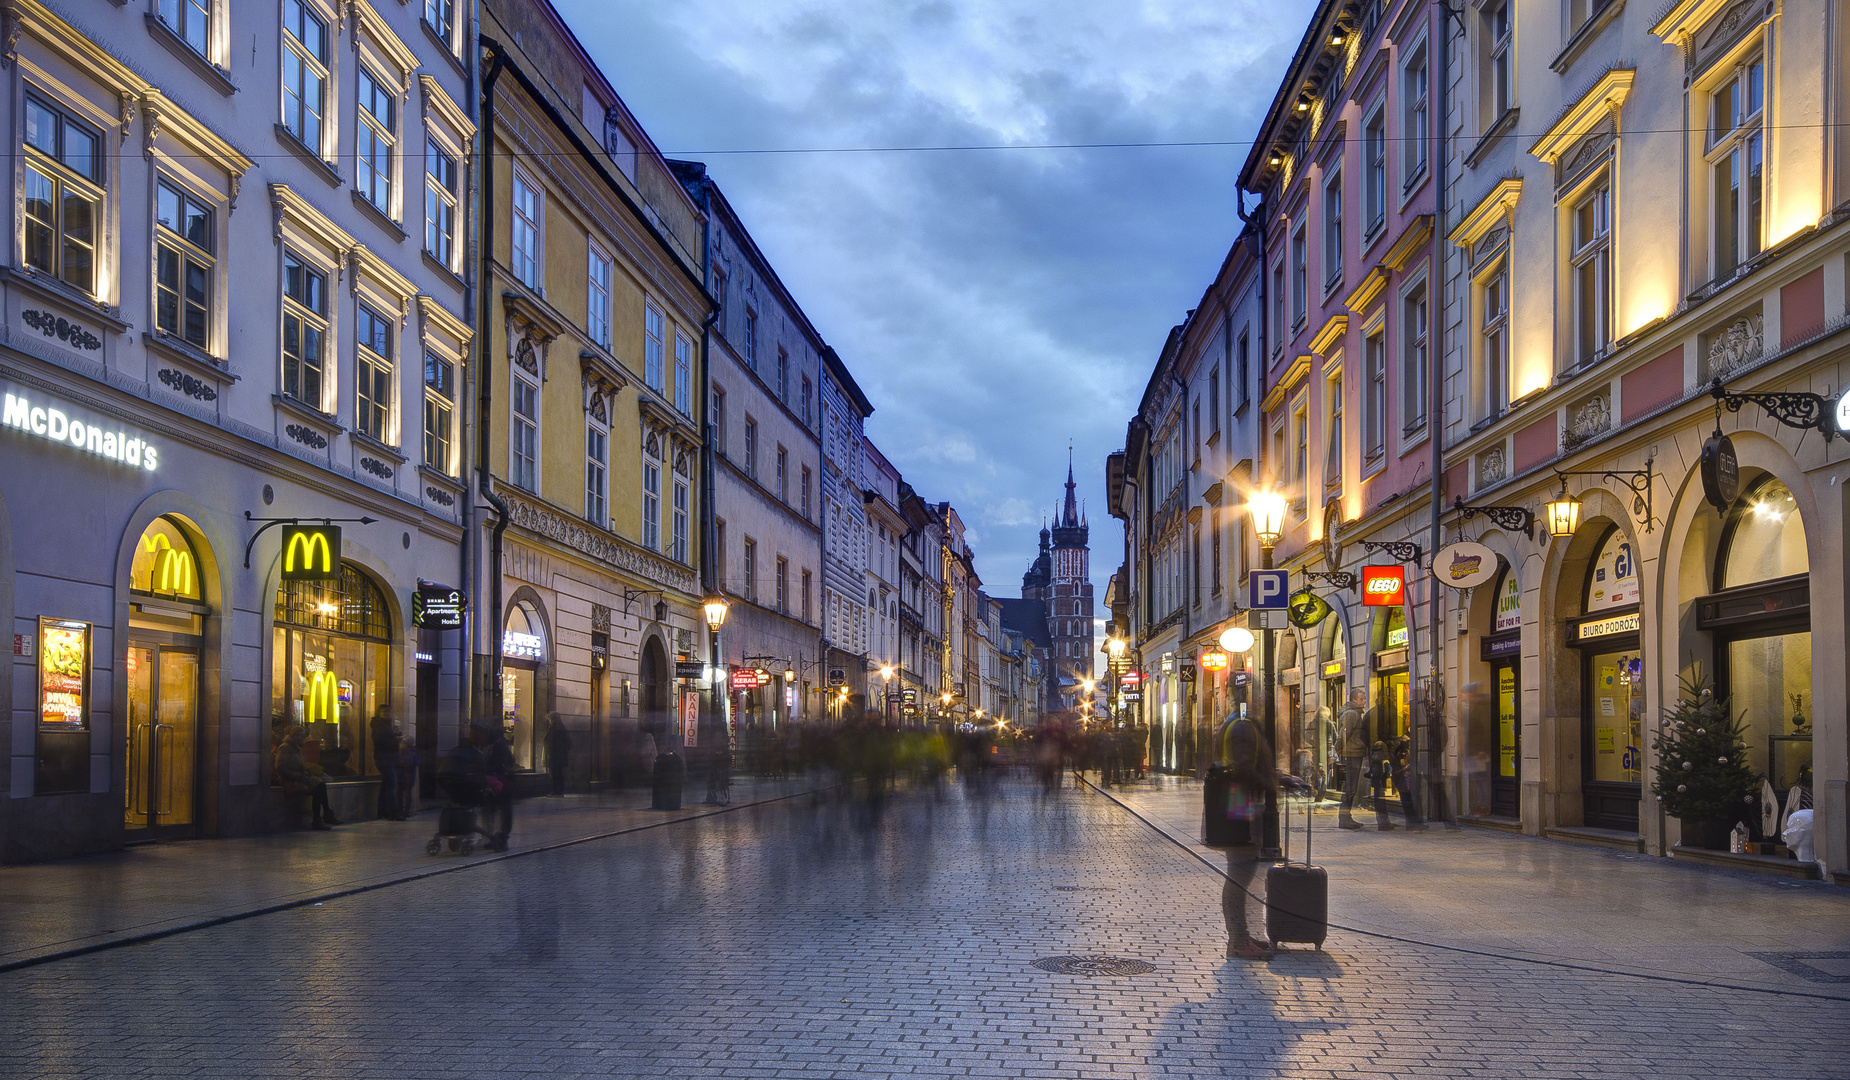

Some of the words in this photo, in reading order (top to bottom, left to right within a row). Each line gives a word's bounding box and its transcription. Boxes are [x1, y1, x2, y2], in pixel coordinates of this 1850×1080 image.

[2, 393, 158, 471] McDonald's
[1257, 574, 1280, 605] P
[1367, 577, 1401, 593] LEGO
[1584, 624, 1603, 636] BIURO
[687, 693, 696, 746] KANTOR
[729, 707, 737, 769] EXCHANE
